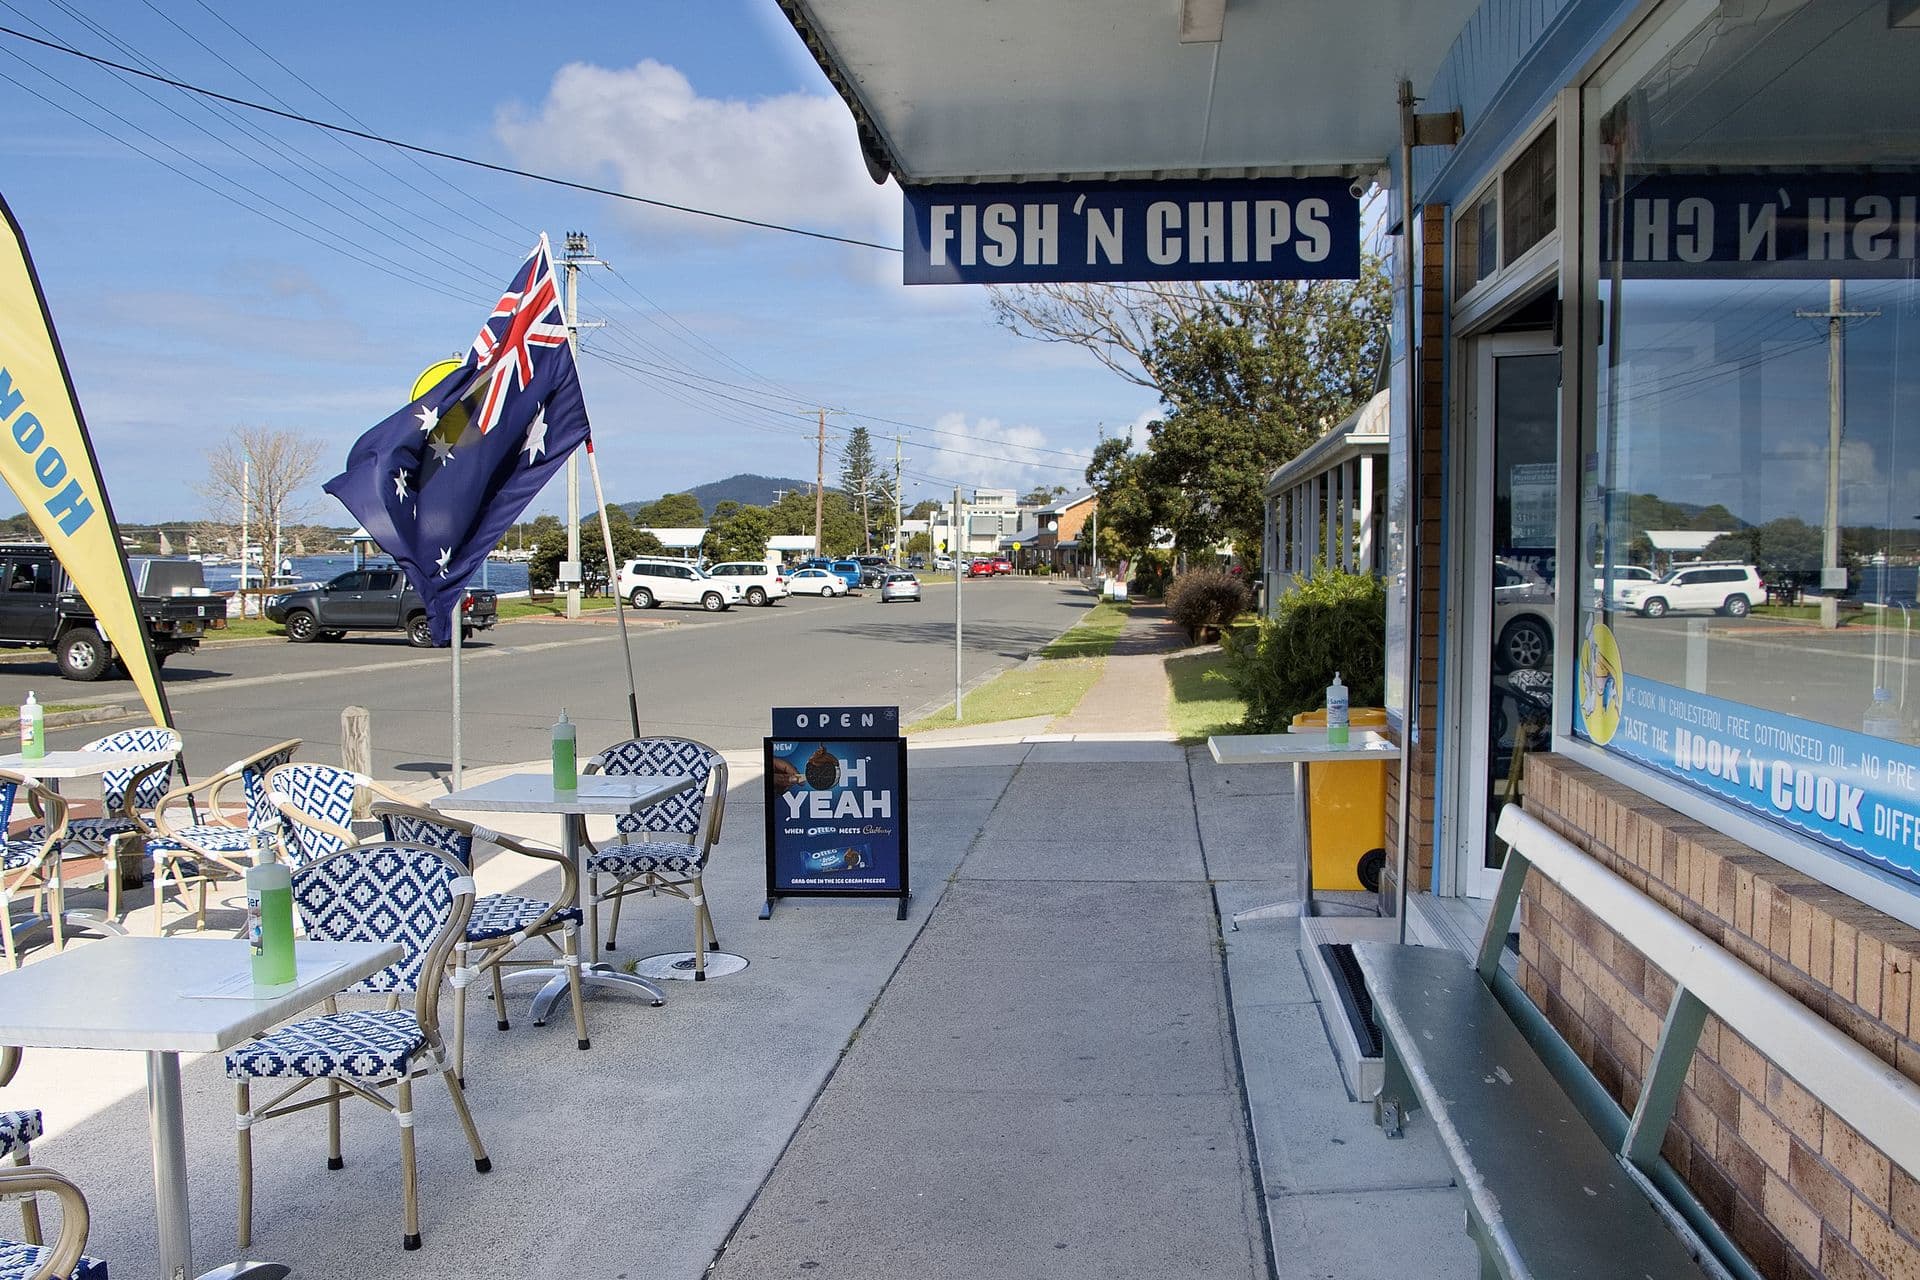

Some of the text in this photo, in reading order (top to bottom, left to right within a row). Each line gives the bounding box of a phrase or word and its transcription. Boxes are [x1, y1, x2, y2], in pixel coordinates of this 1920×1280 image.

[930, 193, 1331, 267] FISH 'N CHIPS
[0, 366, 95, 537] HOOK
[796, 713, 874, 728] OPEN
[1625, 686, 1636, 704] WE
[1639, 689, 1656, 710] COOK
[1658, 695, 1666, 713] IN
[1668, 698, 1723, 732] CHOLESTEROL
[1727, 715, 1751, 741] FREE
[1754, 723, 1823, 762] COTTONSEED
[1828, 744, 1849, 770] OIL
[1861, 752, 1880, 780] NO
[773, 743, 793, 752] NEW
[1623, 716, 1648, 745] TASTE
[1651, 726, 1669, 753] THE
[1675, 726, 1741, 786] HOOK
[1770, 760, 1865, 834] COOK
[782, 790, 892, 819] YEAH
[807, 826, 836, 836] OREO
[839, 827, 860, 835] MEETS
